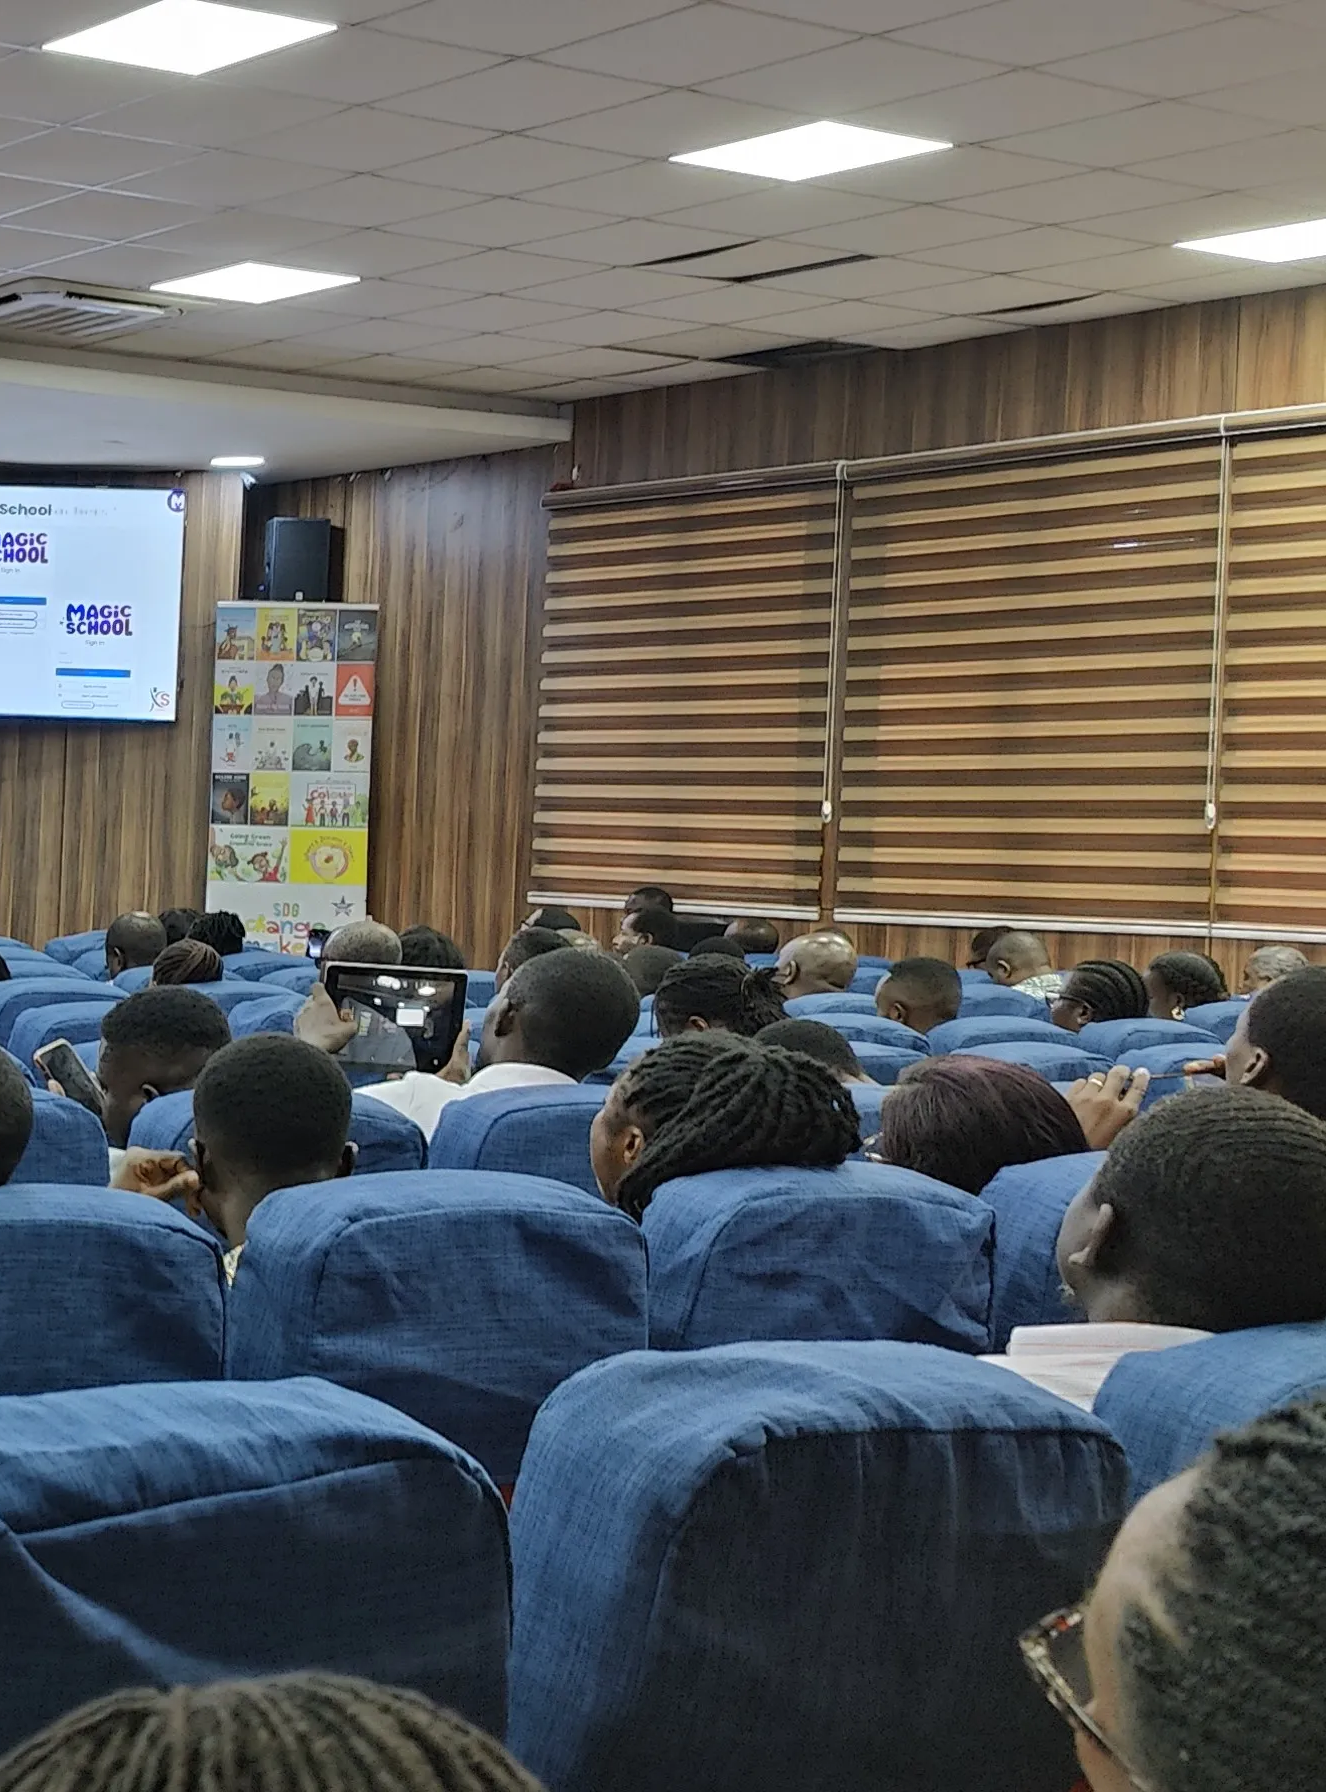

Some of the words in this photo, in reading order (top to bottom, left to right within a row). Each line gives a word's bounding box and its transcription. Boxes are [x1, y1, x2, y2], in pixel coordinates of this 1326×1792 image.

[66, 619, 133, 636] SCHOOL
[251, 832, 272, 841] Green
[273, 902, 300, 918] SDG
